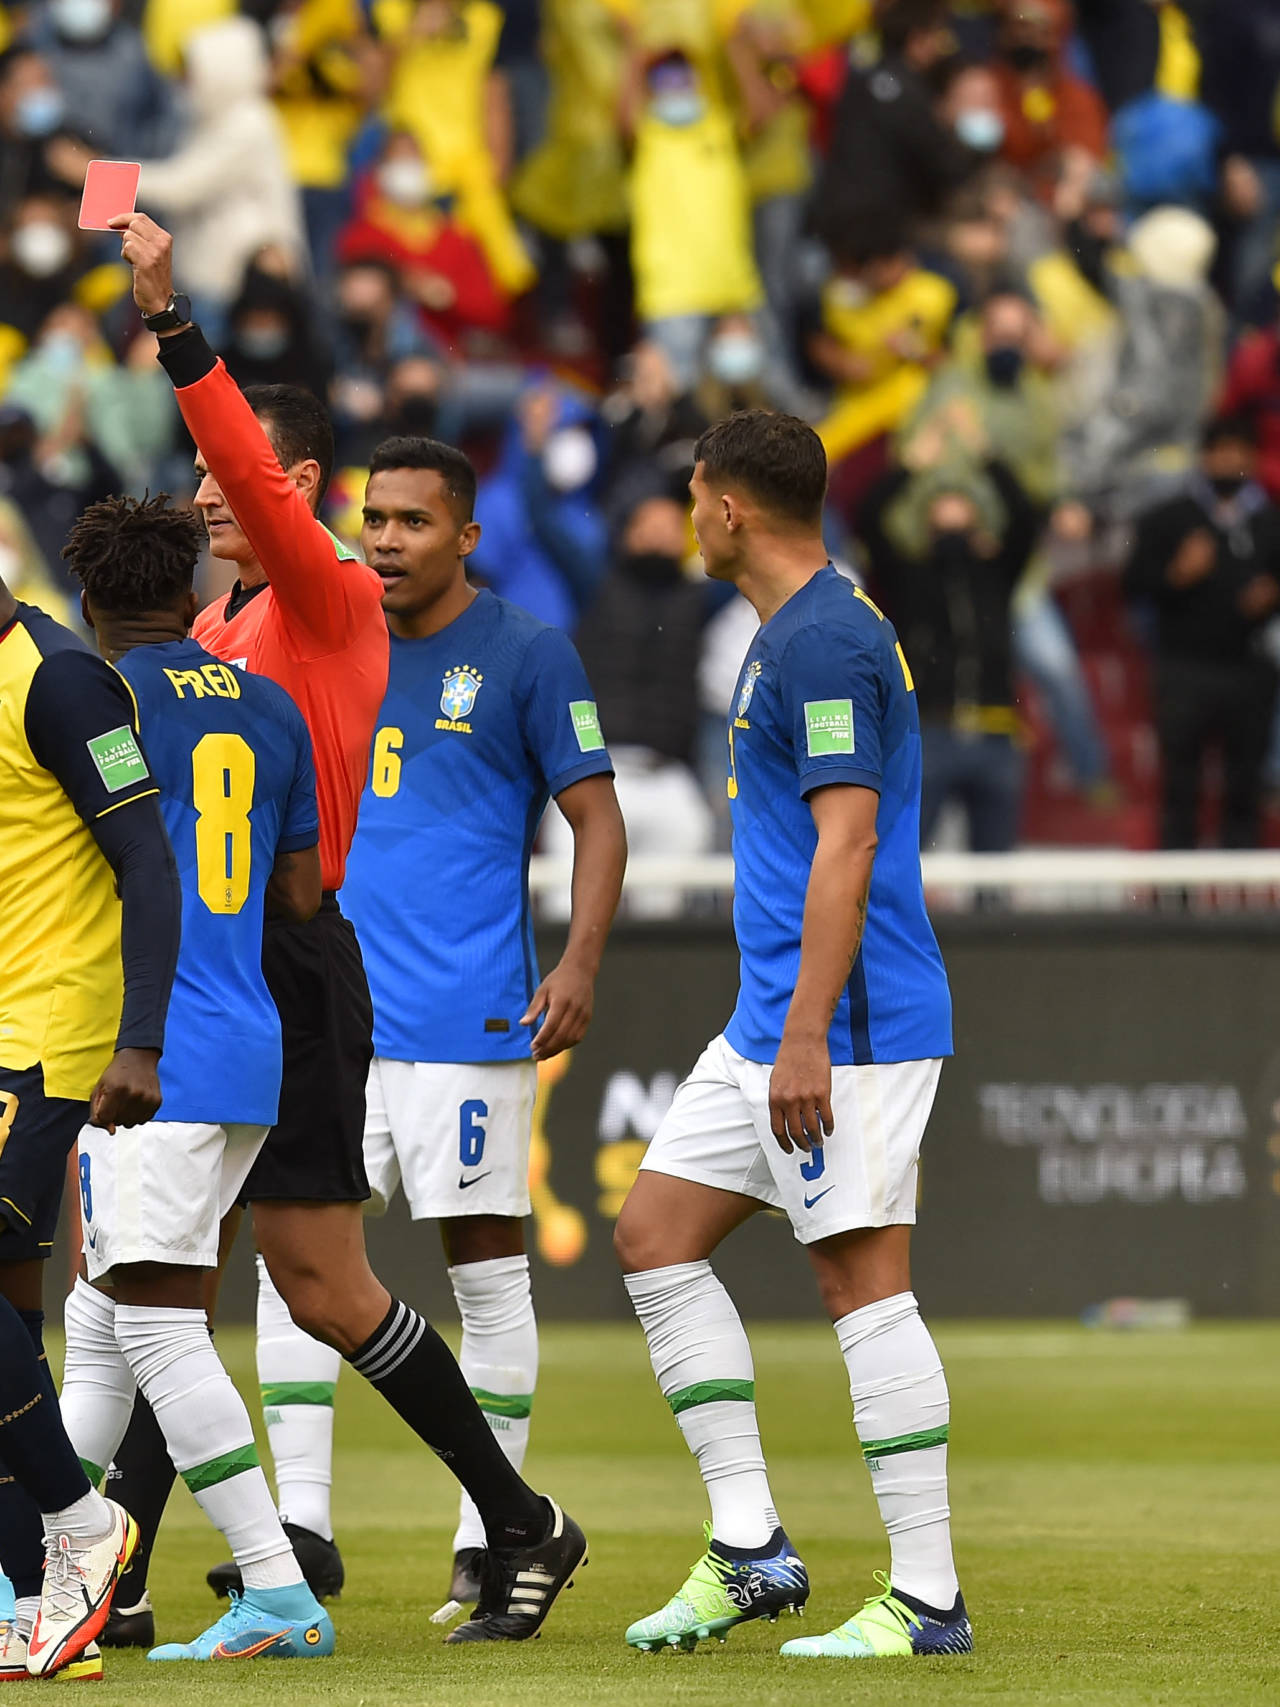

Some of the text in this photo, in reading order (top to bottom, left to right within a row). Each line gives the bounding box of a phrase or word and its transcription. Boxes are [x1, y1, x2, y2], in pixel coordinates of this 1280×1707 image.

[162, 663, 242, 700] FRED
[434, 719, 473, 734] BRASIL
[372, 726, 404, 798] 6
[192, 733, 255, 914] 8
[459, 1099, 488, 1166] 6
